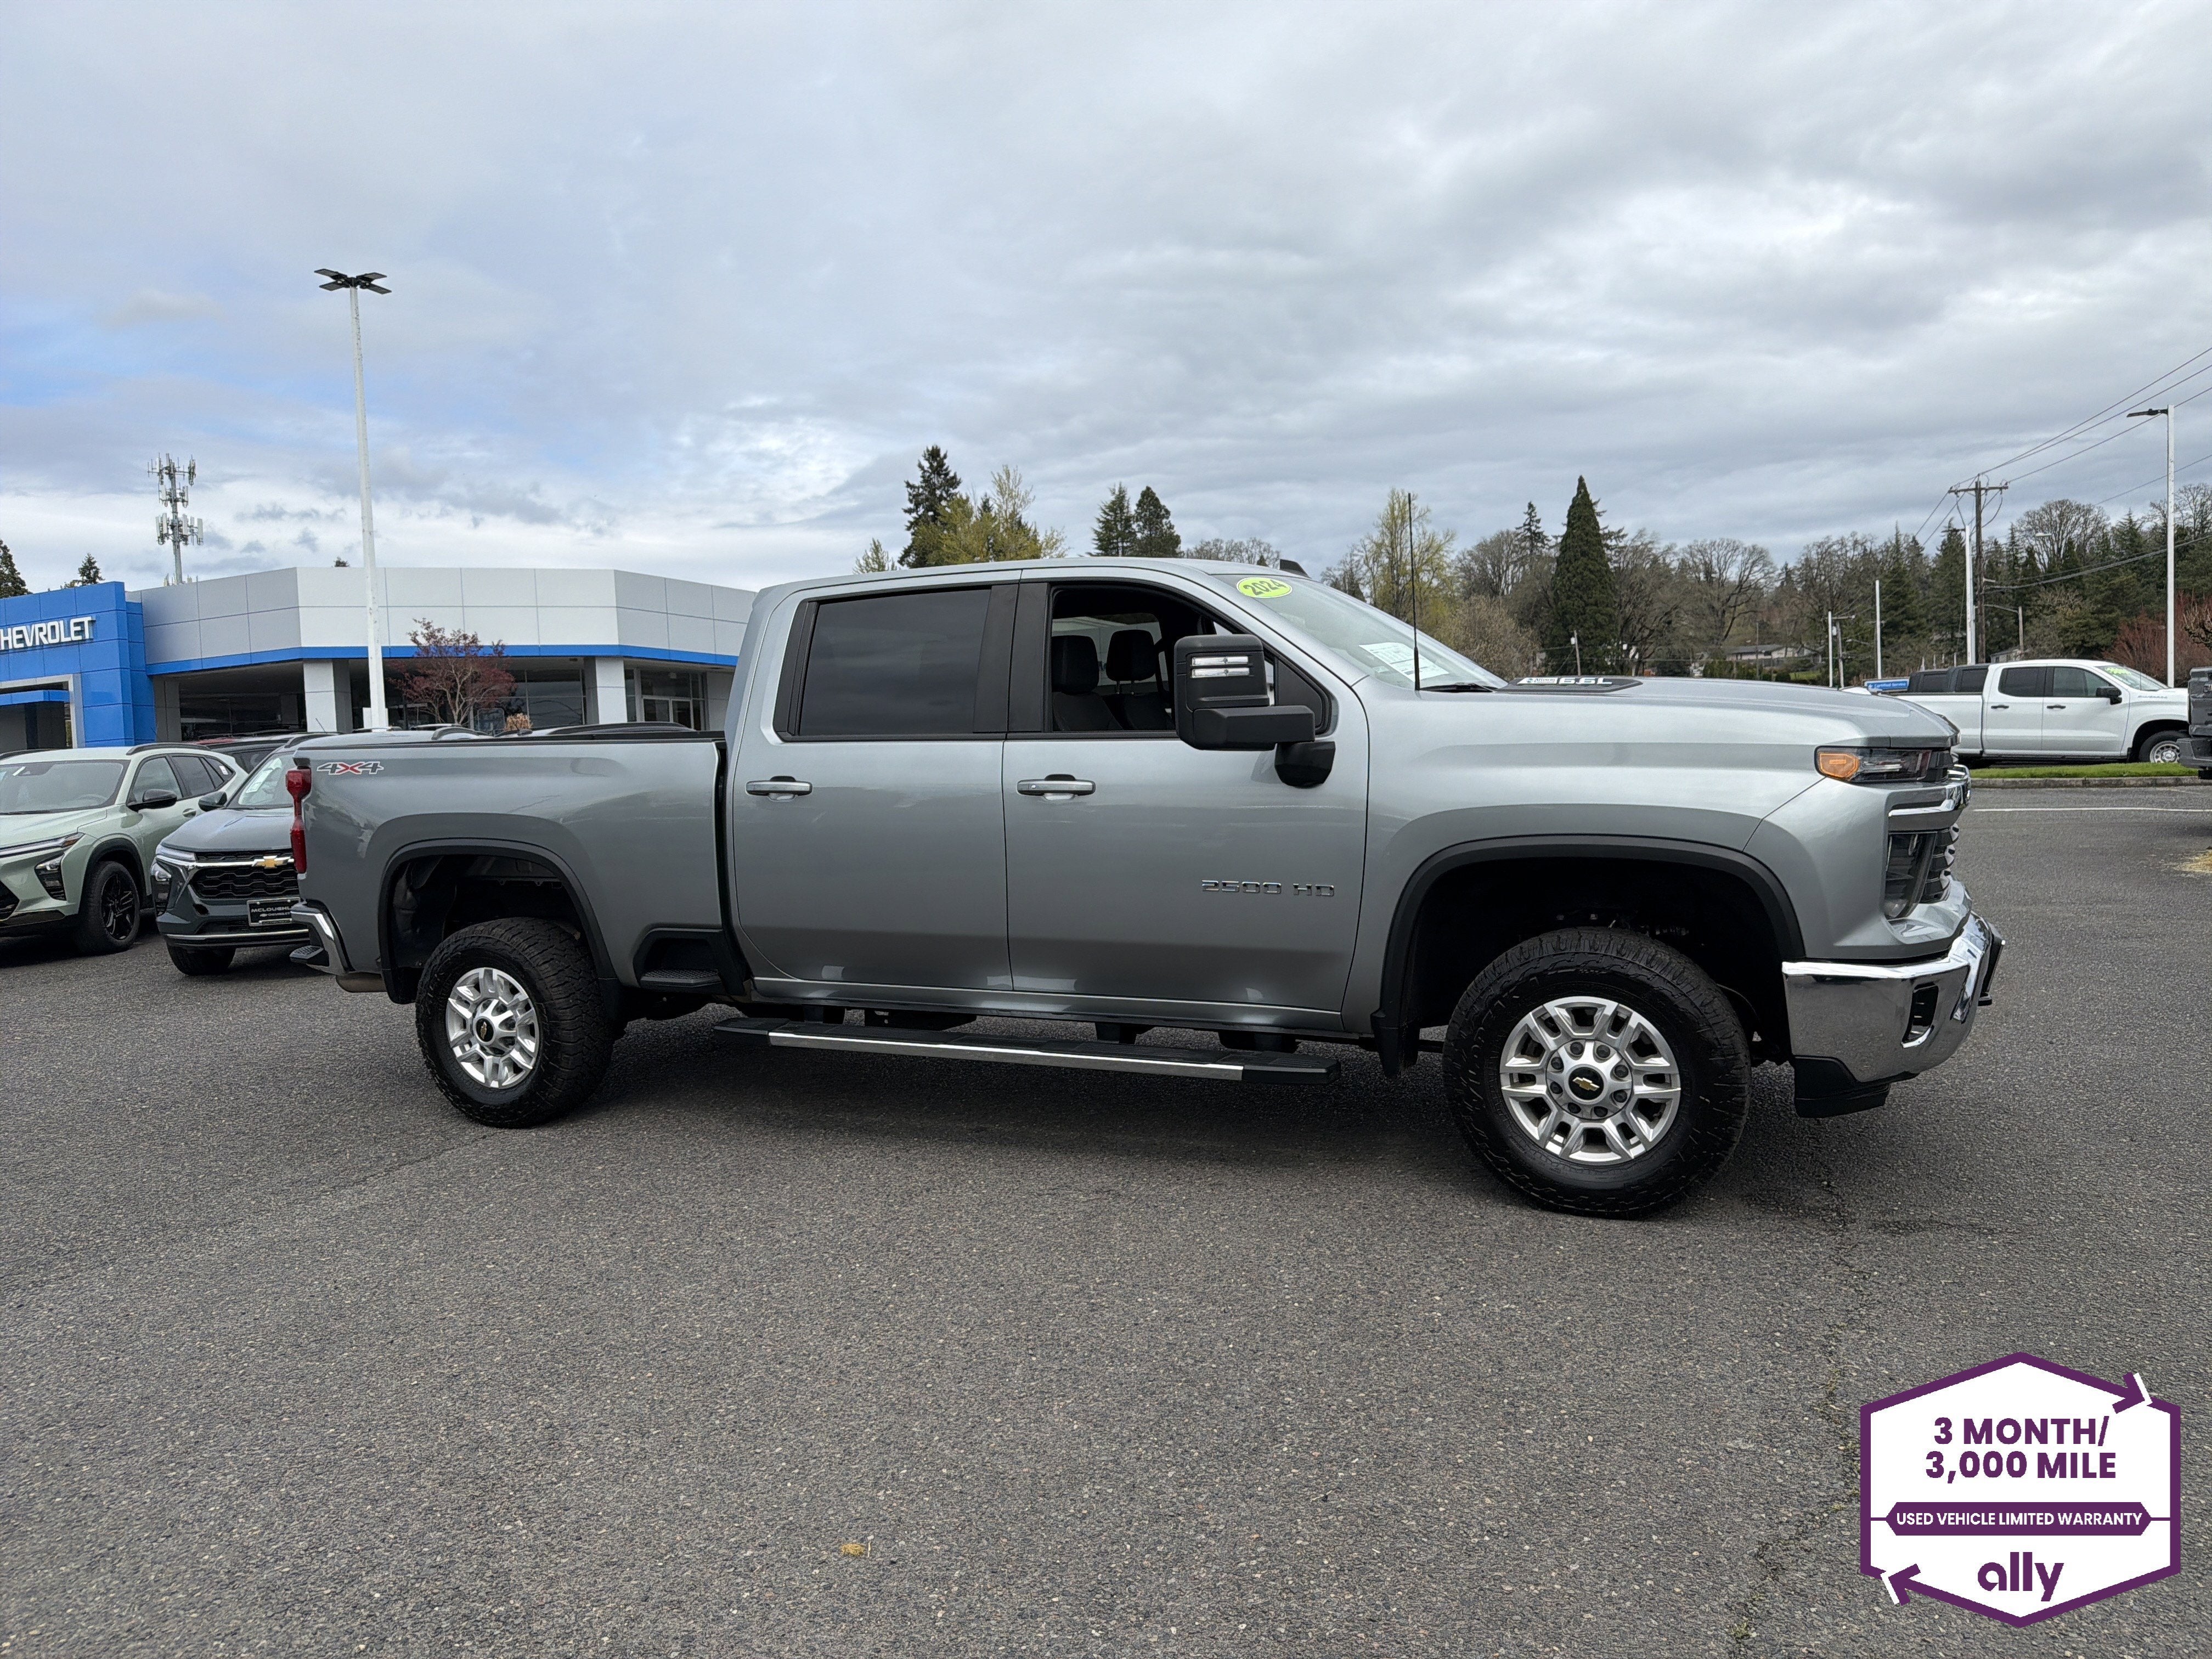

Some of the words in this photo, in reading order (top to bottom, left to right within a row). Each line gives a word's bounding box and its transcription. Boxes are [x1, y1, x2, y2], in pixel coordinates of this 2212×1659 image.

[1243, 579, 1287, 596] 2024
[0, 616, 92, 650] HEVROLET
[317, 761, 384, 775] 4X4
[1201, 879, 1282, 894] 2500
[1293, 883, 1335, 897] HD
